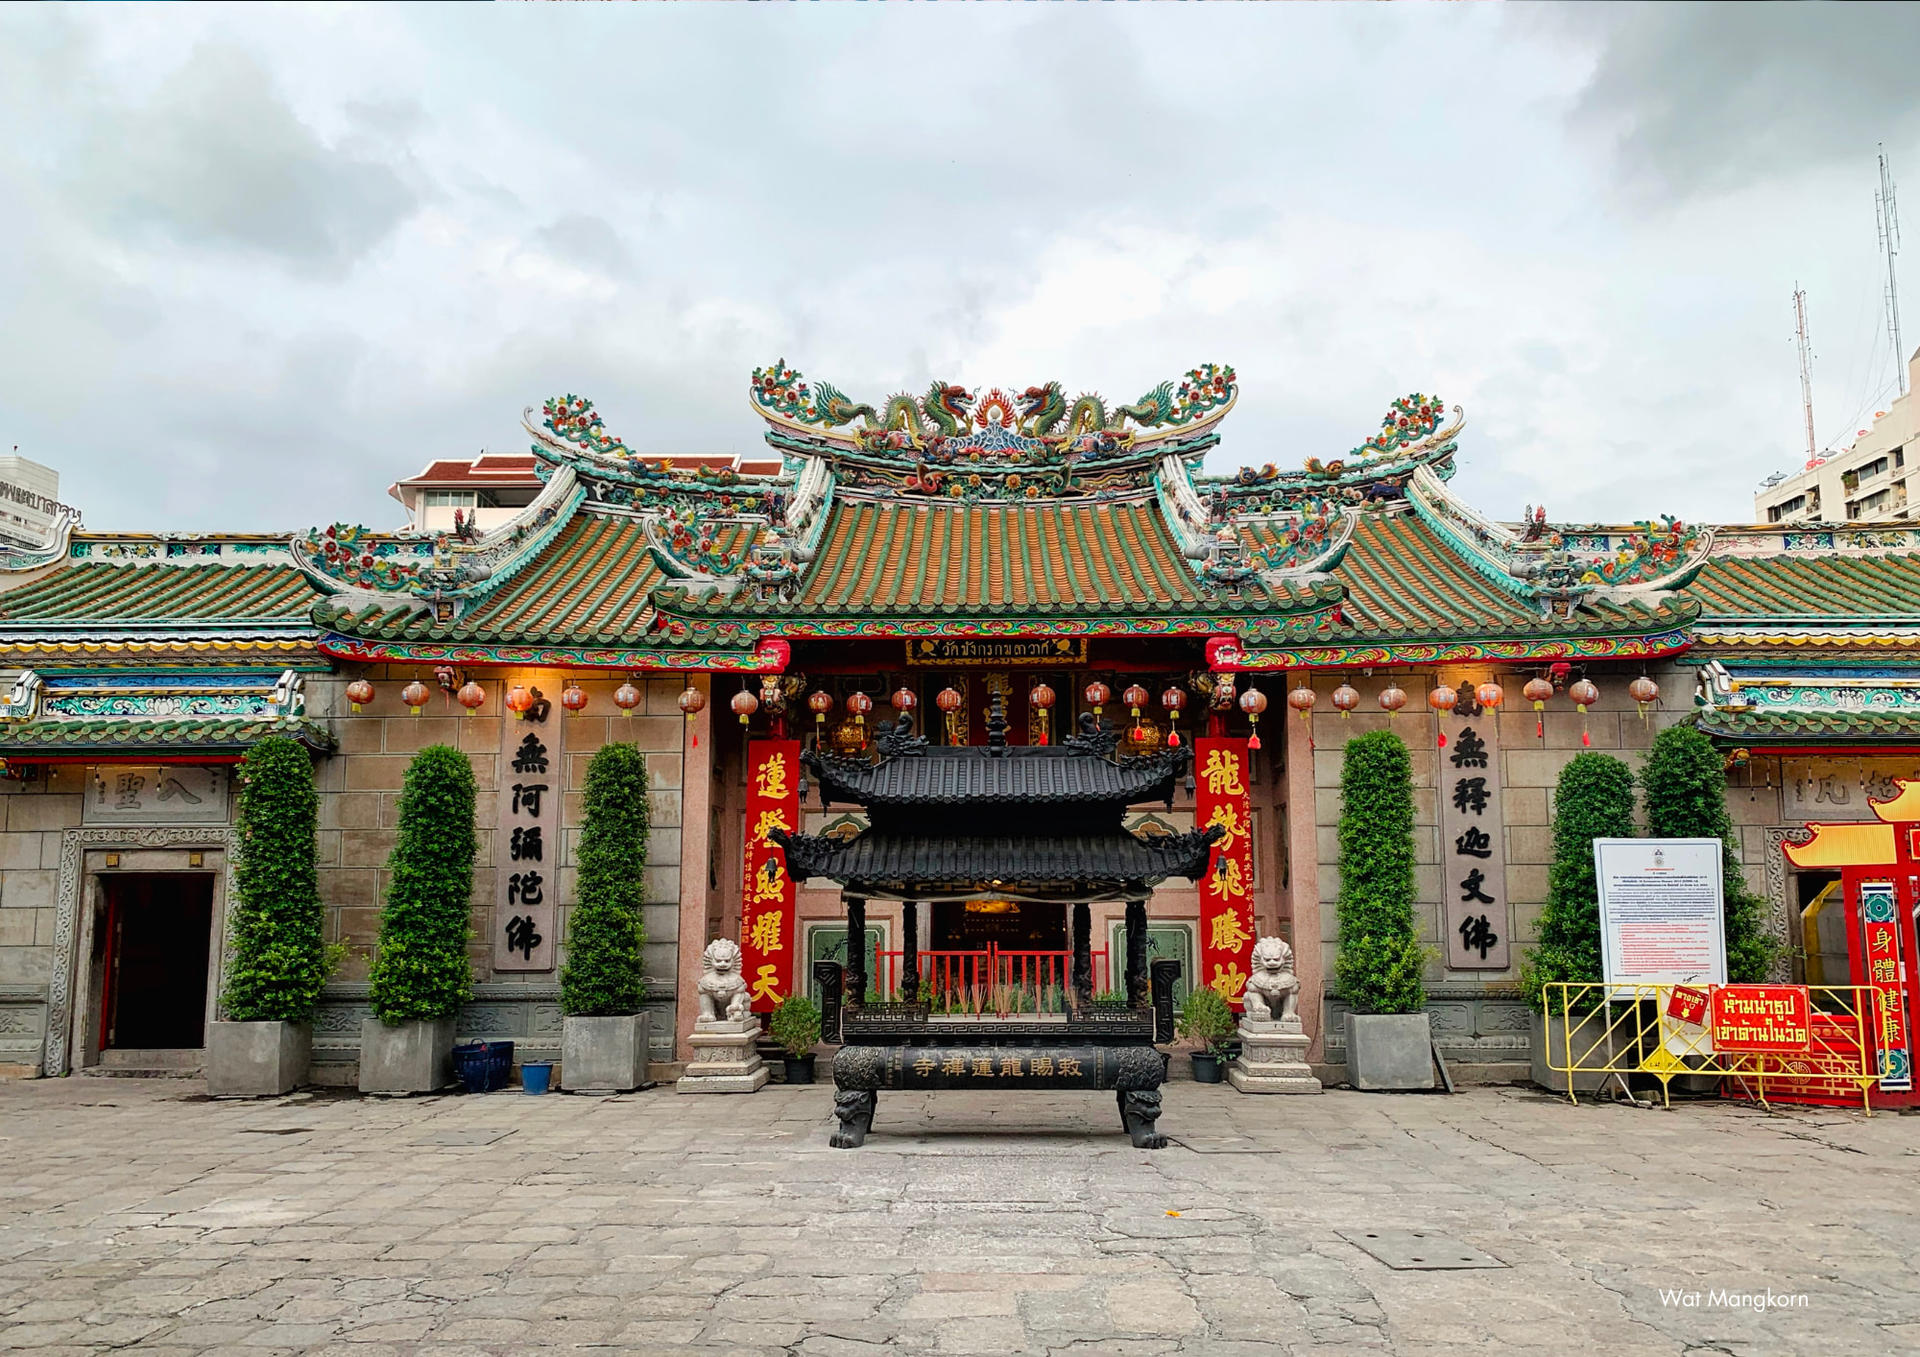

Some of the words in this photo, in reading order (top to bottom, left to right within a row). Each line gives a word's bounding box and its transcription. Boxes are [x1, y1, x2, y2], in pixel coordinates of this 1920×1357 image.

[1872, 927, 1901, 1043] 身體健康
[1723, 991, 1795, 1021] ห้ามนำธูป
[1716, 1018, 1807, 1043] เข้าด้านในวัด
